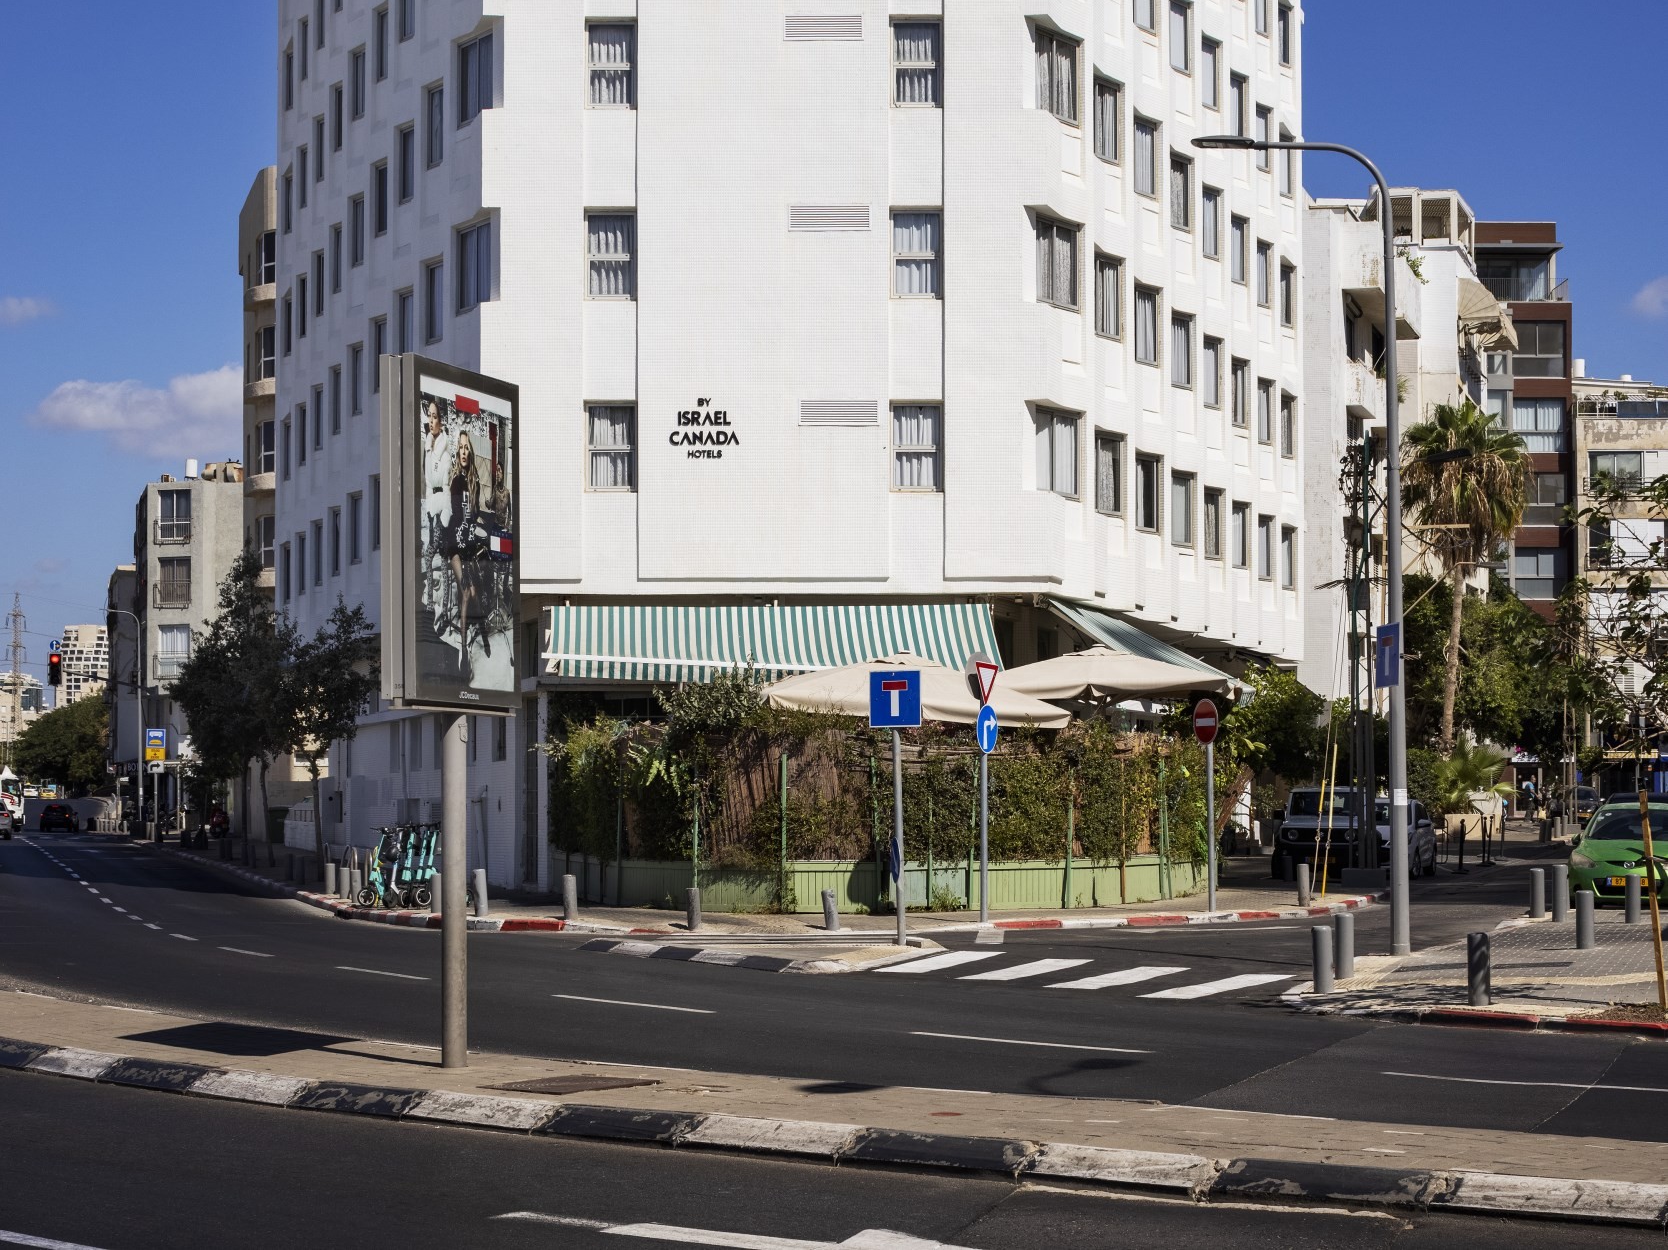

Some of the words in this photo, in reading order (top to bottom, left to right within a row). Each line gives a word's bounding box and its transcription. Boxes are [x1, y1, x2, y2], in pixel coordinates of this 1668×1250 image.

[697, 397, 711, 408] BY
[677, 411, 731, 427] ISRAEL
[669, 430, 740, 446] CANADA
[687, 450, 723, 459] HOTELS
